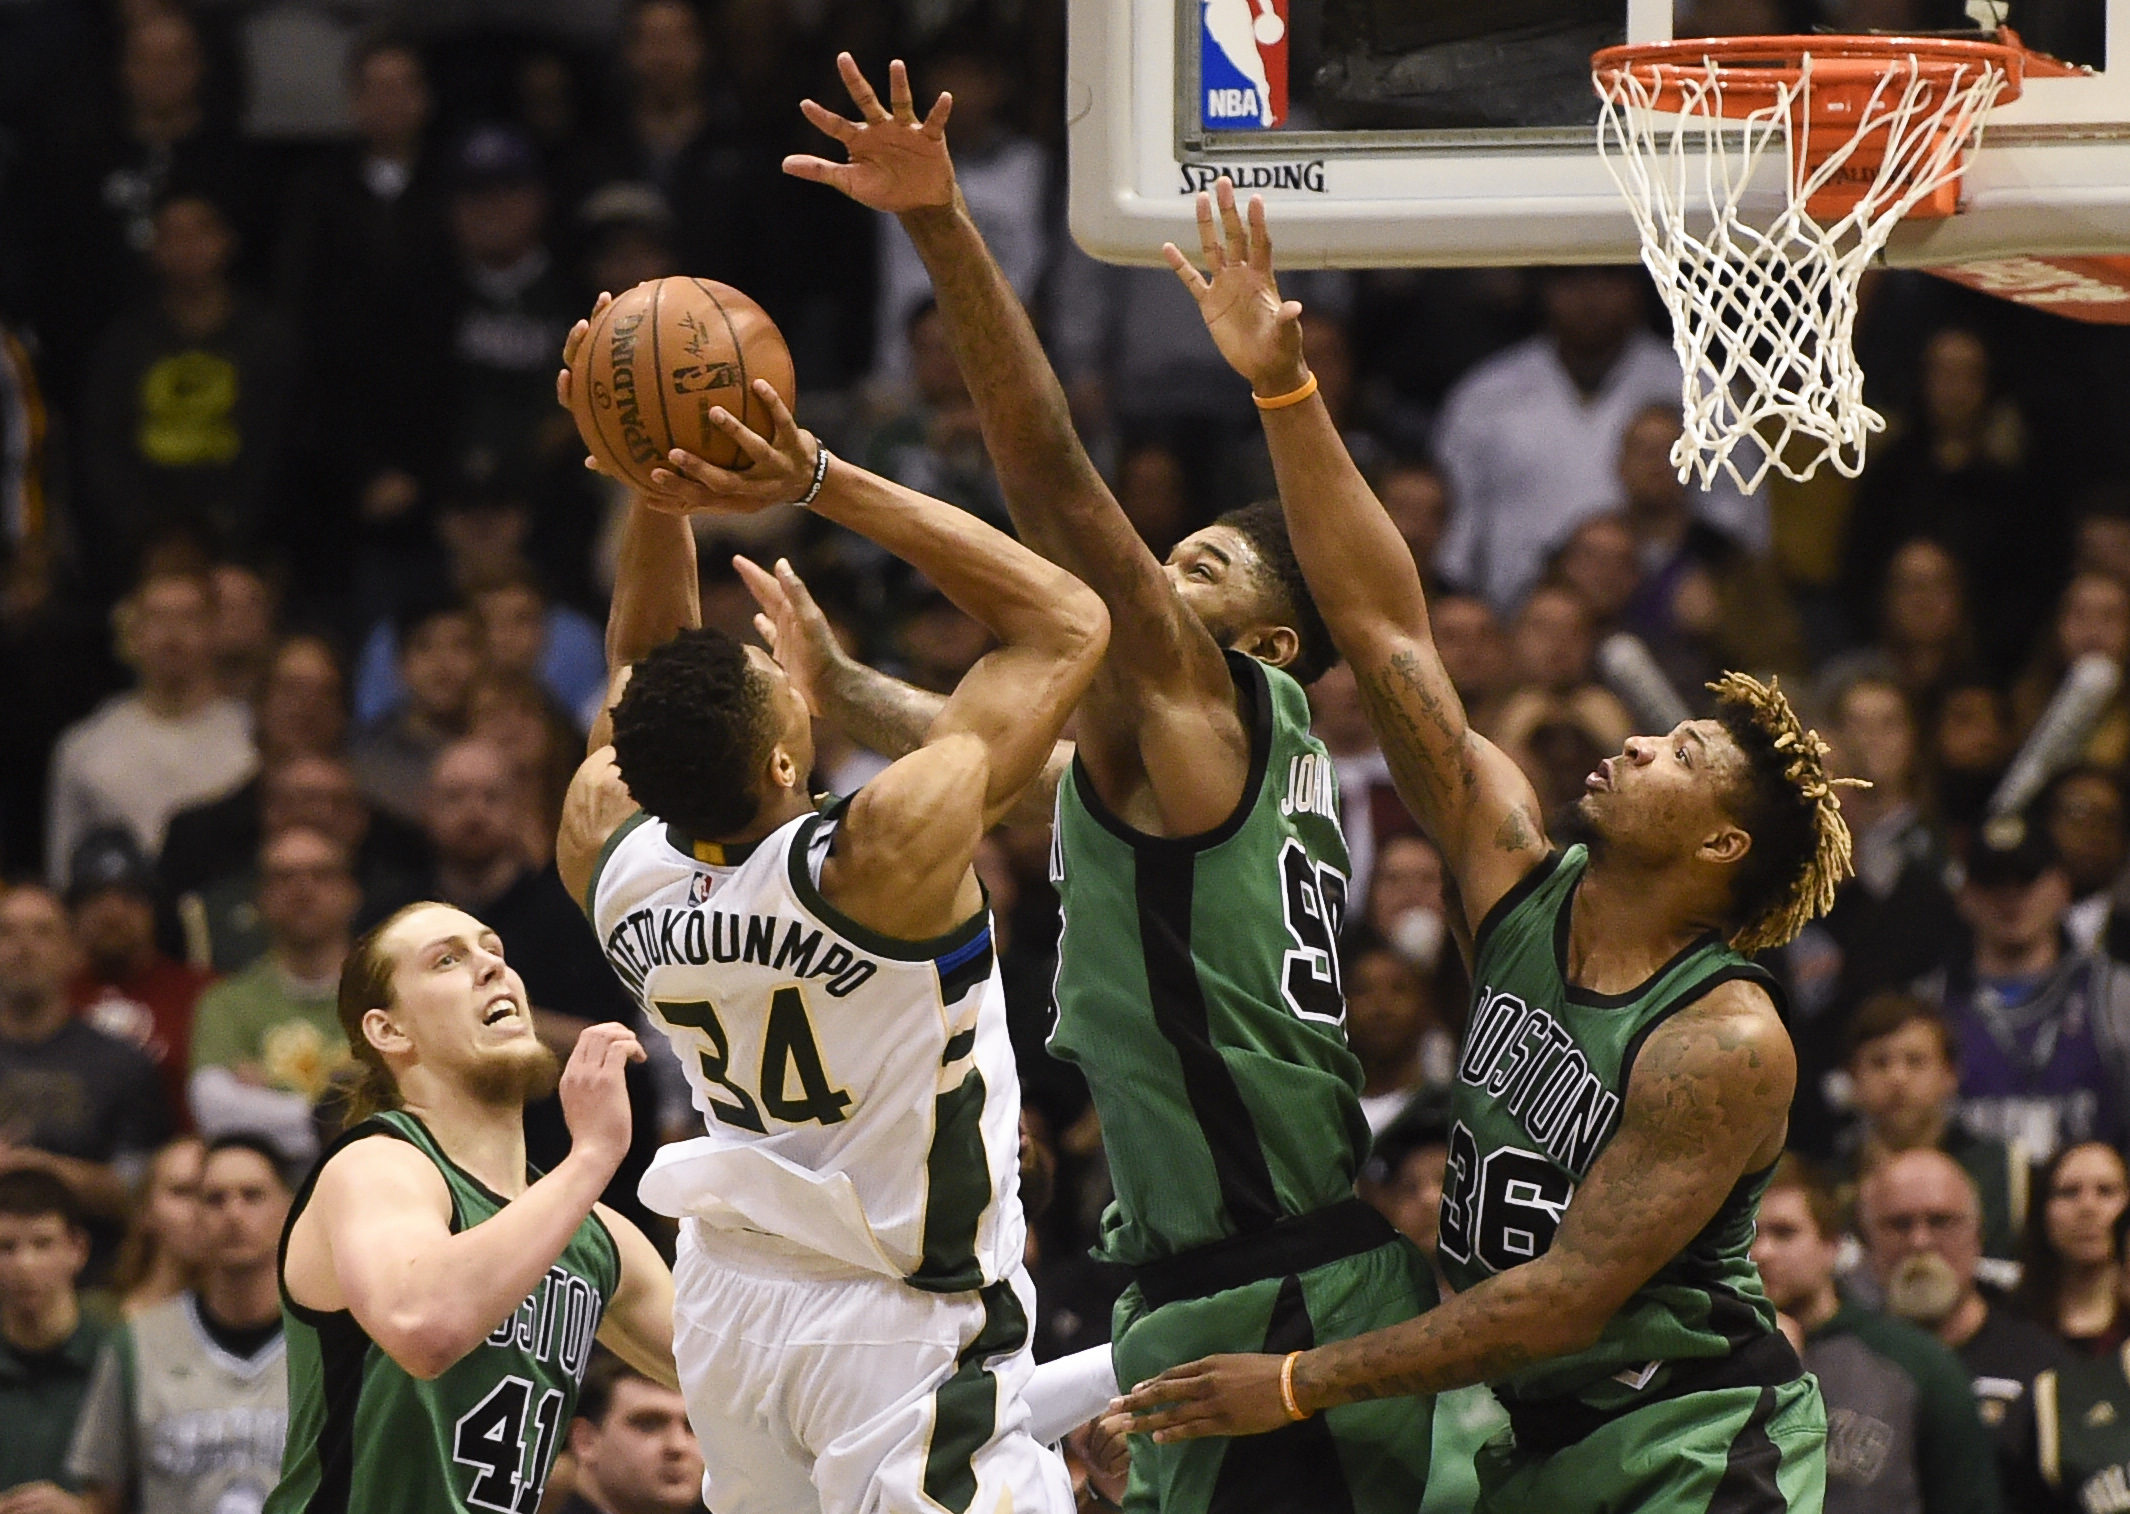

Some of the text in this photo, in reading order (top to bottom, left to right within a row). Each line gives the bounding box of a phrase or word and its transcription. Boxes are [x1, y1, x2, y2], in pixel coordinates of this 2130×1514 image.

[1179, 159, 1325, 195] SPALDING
[1208, 88, 1259, 118] NBA
[611, 312, 664, 464] SPALDING
[650, 985, 855, 1136] 34
[1457, 985, 1620, 1176] OSTON
[1438, 1118, 1576, 1274] 36
[453, 1374, 565, 1514] 41
